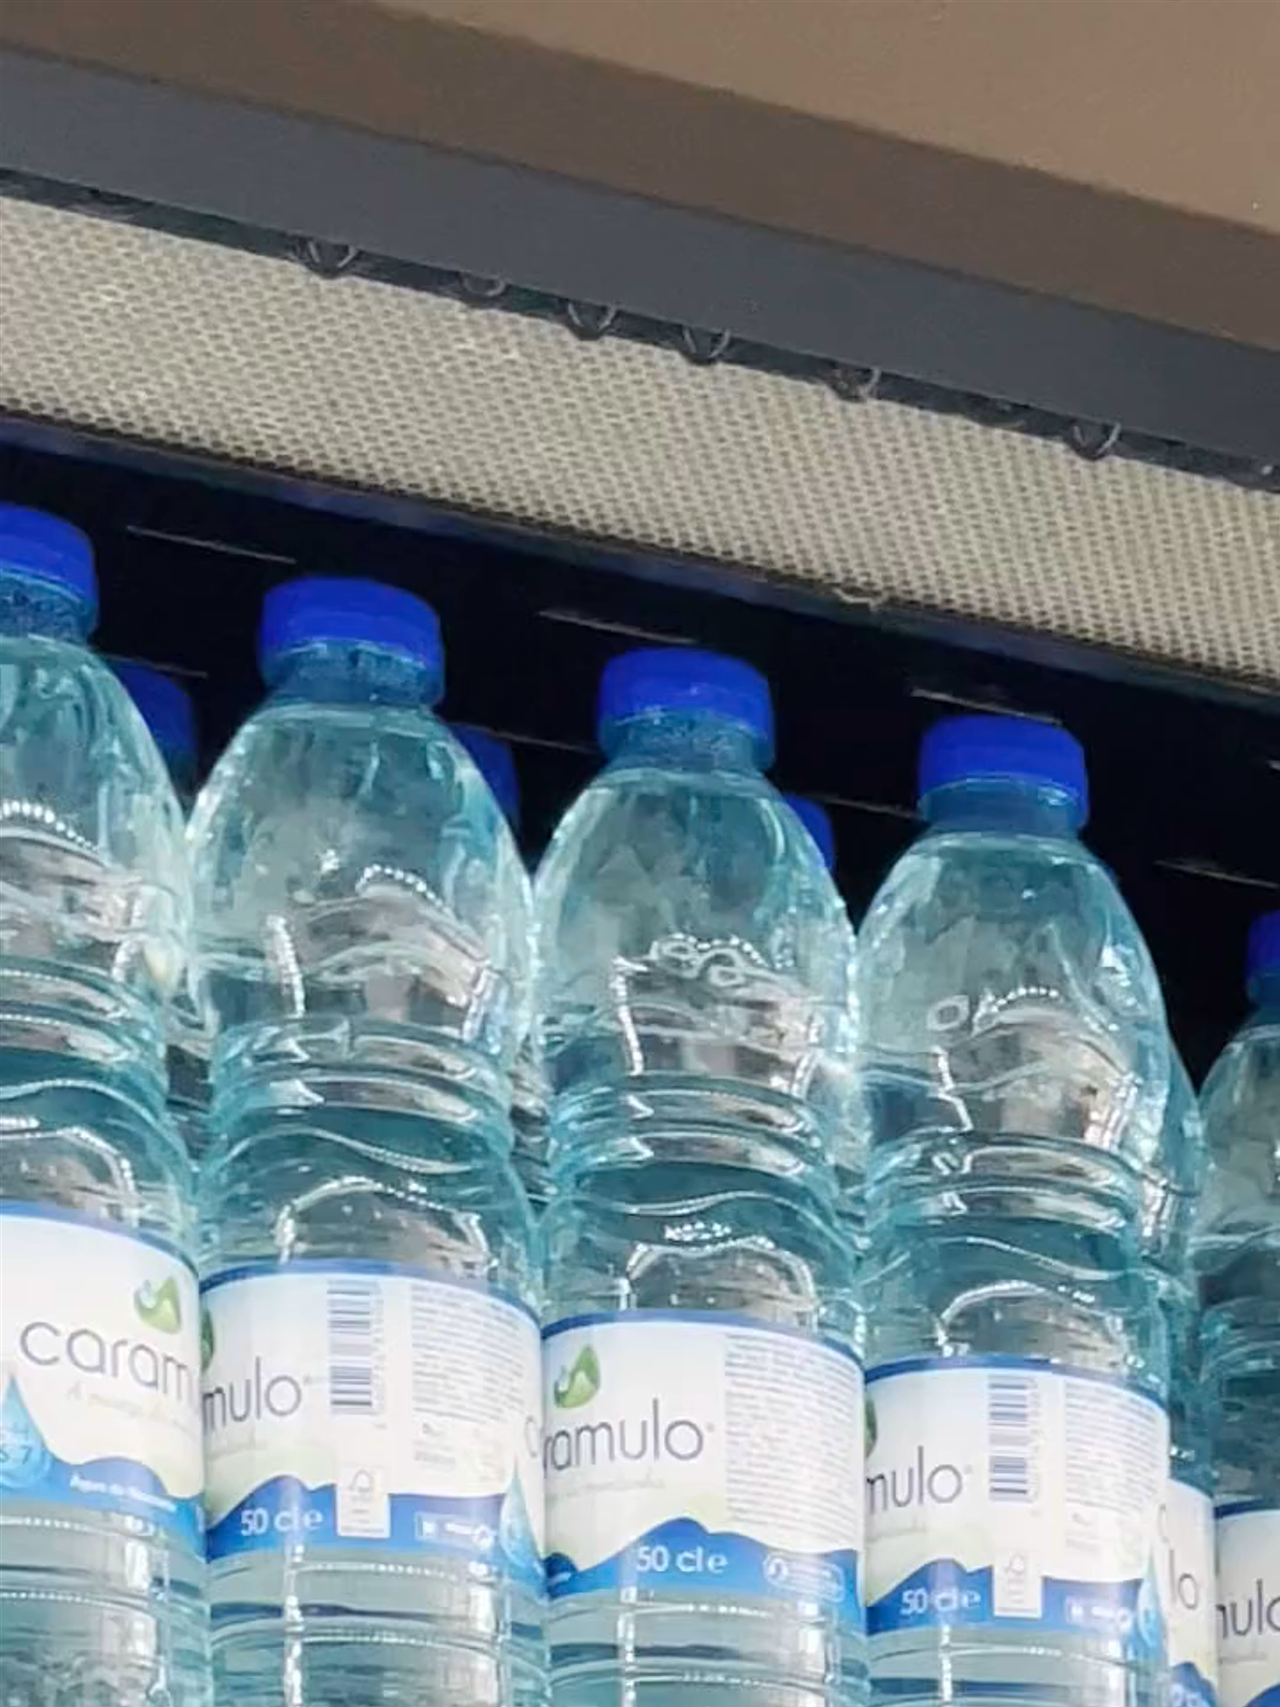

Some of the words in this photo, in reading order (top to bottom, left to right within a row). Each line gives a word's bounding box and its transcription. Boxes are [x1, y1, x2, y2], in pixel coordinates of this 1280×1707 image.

[242, 1508, 267, 1536] 50
[636, 1547, 668, 1572] 50
[903, 1590, 928, 1615] 50
